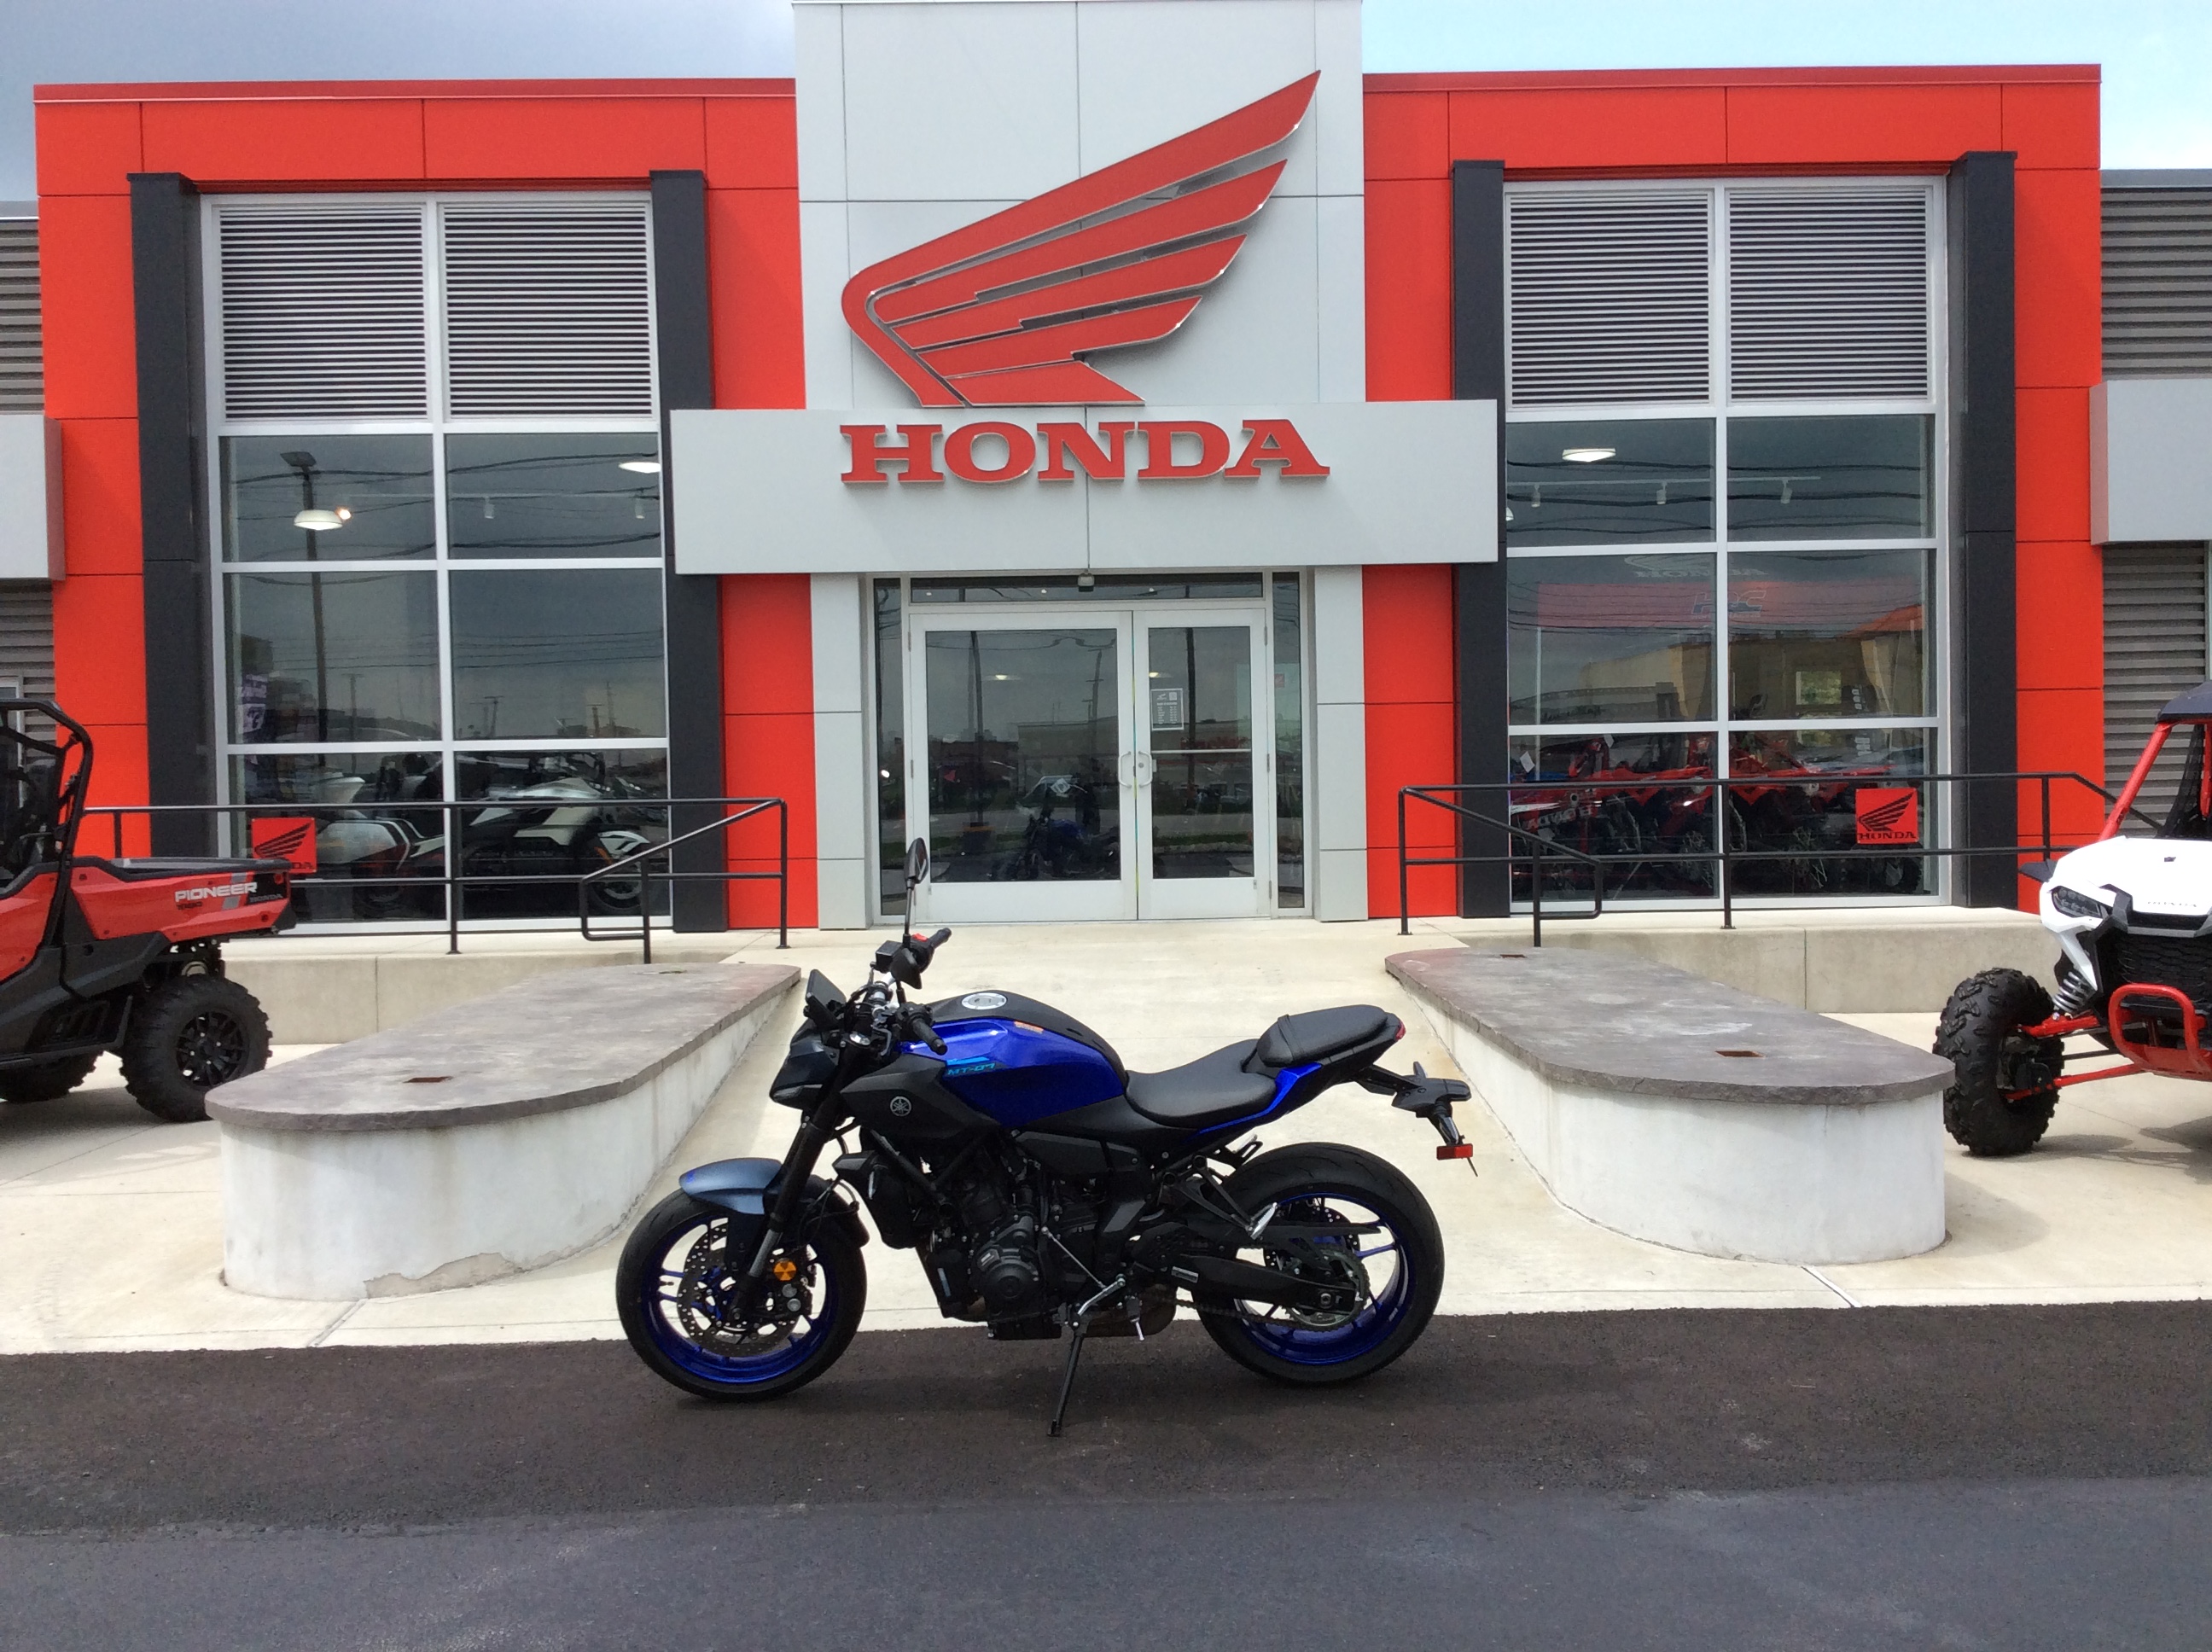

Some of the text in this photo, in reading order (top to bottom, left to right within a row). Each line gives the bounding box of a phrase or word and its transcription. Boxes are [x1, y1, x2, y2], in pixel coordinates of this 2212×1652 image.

[841, 419, 1330, 483] HONDA
[1858, 831, 1917, 840] HONDA
[175, 882, 258, 902] PIONEER
[947, 1062, 996, 1075] MT-07
